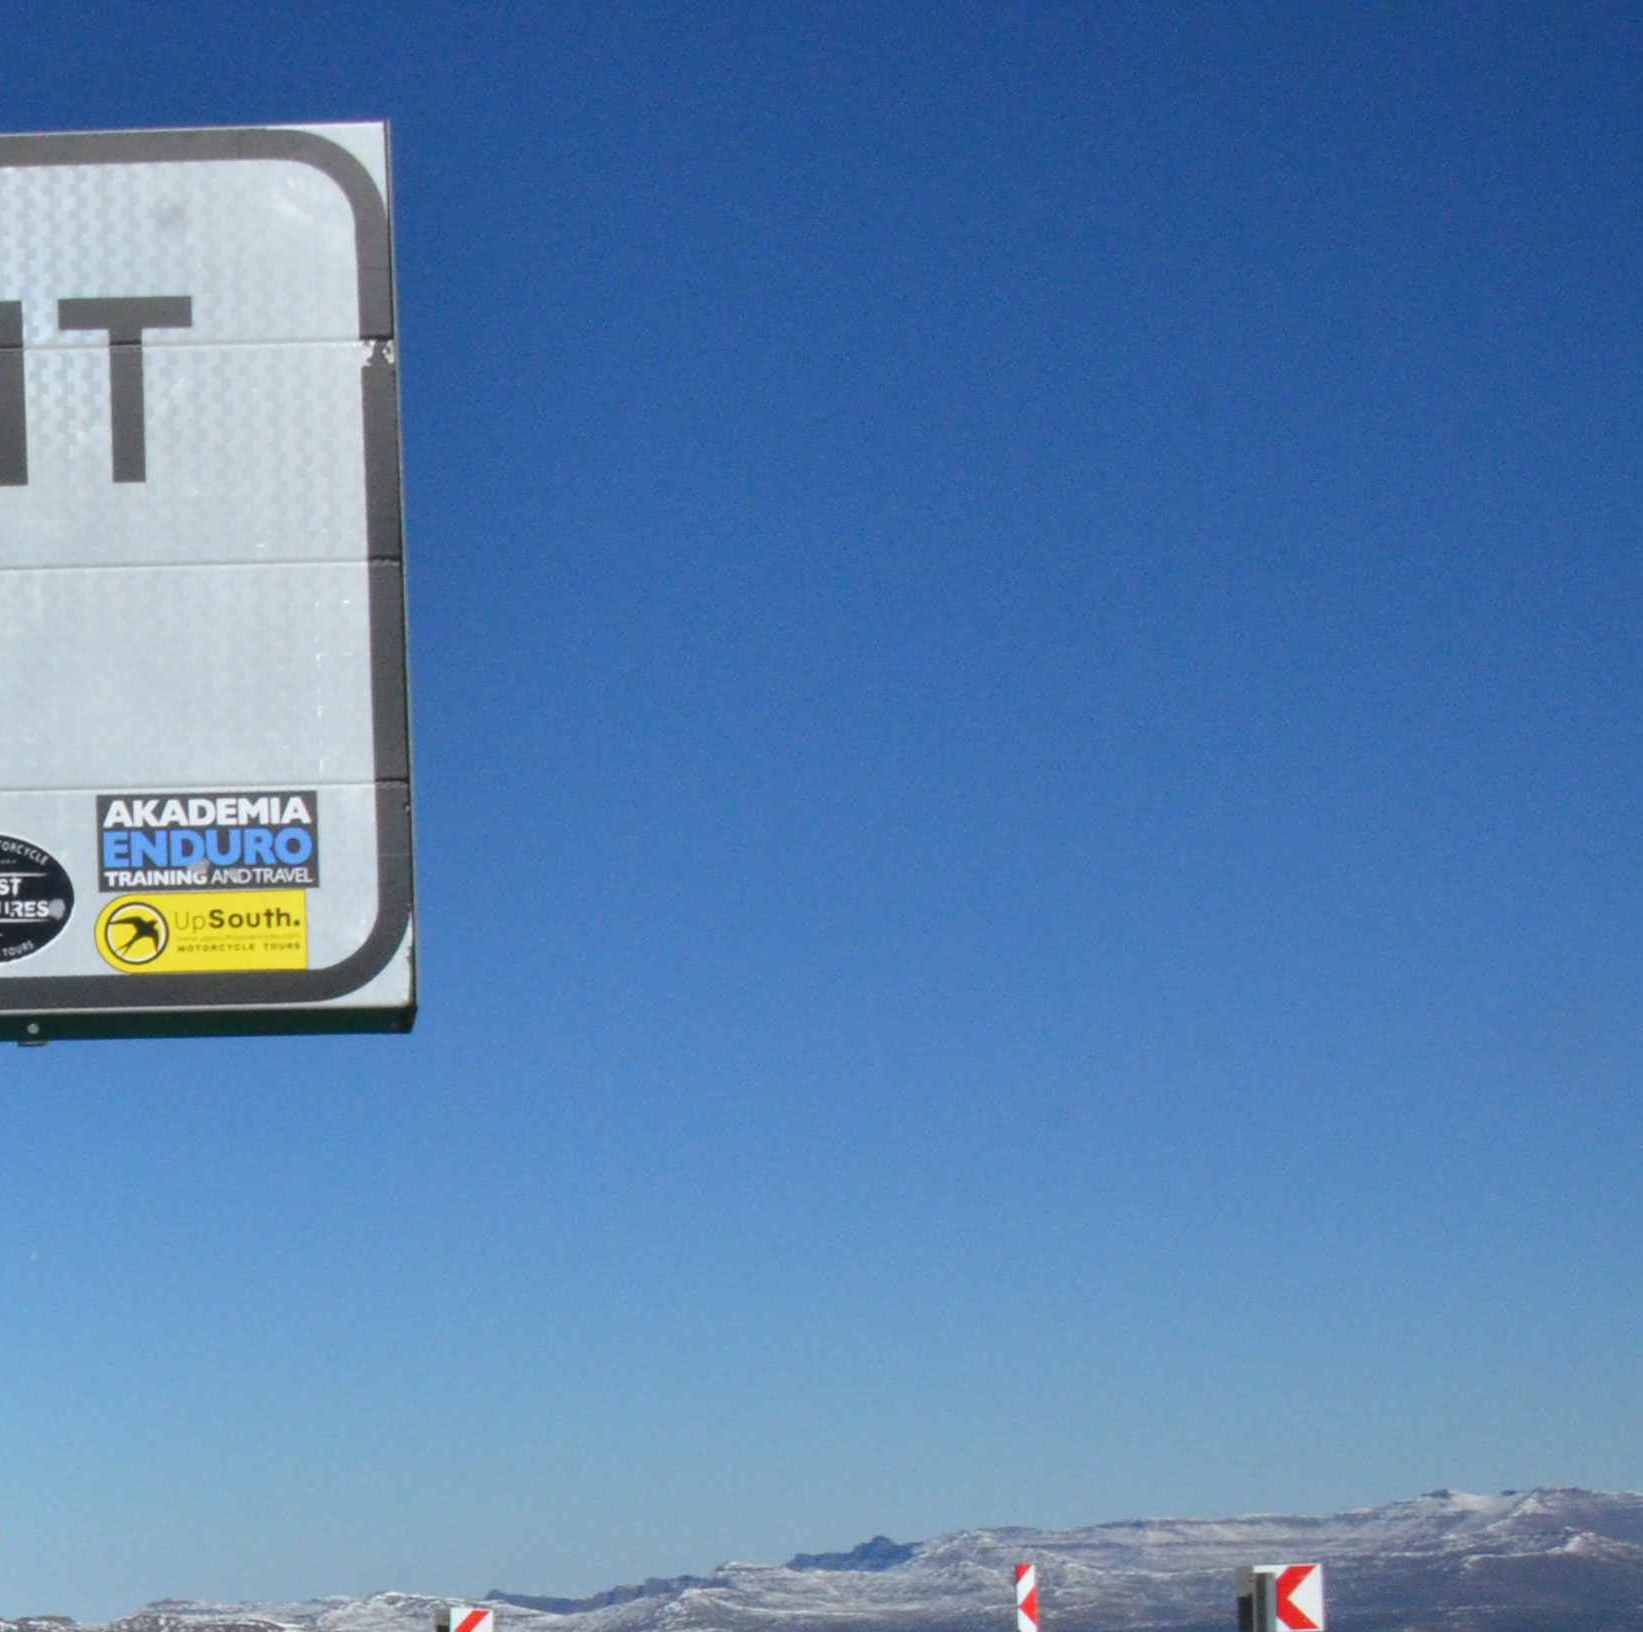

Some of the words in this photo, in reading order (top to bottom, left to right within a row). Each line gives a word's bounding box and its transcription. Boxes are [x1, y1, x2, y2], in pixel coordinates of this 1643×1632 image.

[103, 796, 312, 828] AKADEMIA
[102, 826, 313, 868] ENDURO
[104, 868, 208, 887] TRAINING
[210, 868, 252, 885] AND
[251, 867, 313, 884] TRAVEL
[2, 939, 35, 957] TOURS
[178, 943, 255, 952] MOTORCYCLE
[263, 942, 301, 951] TOURS
